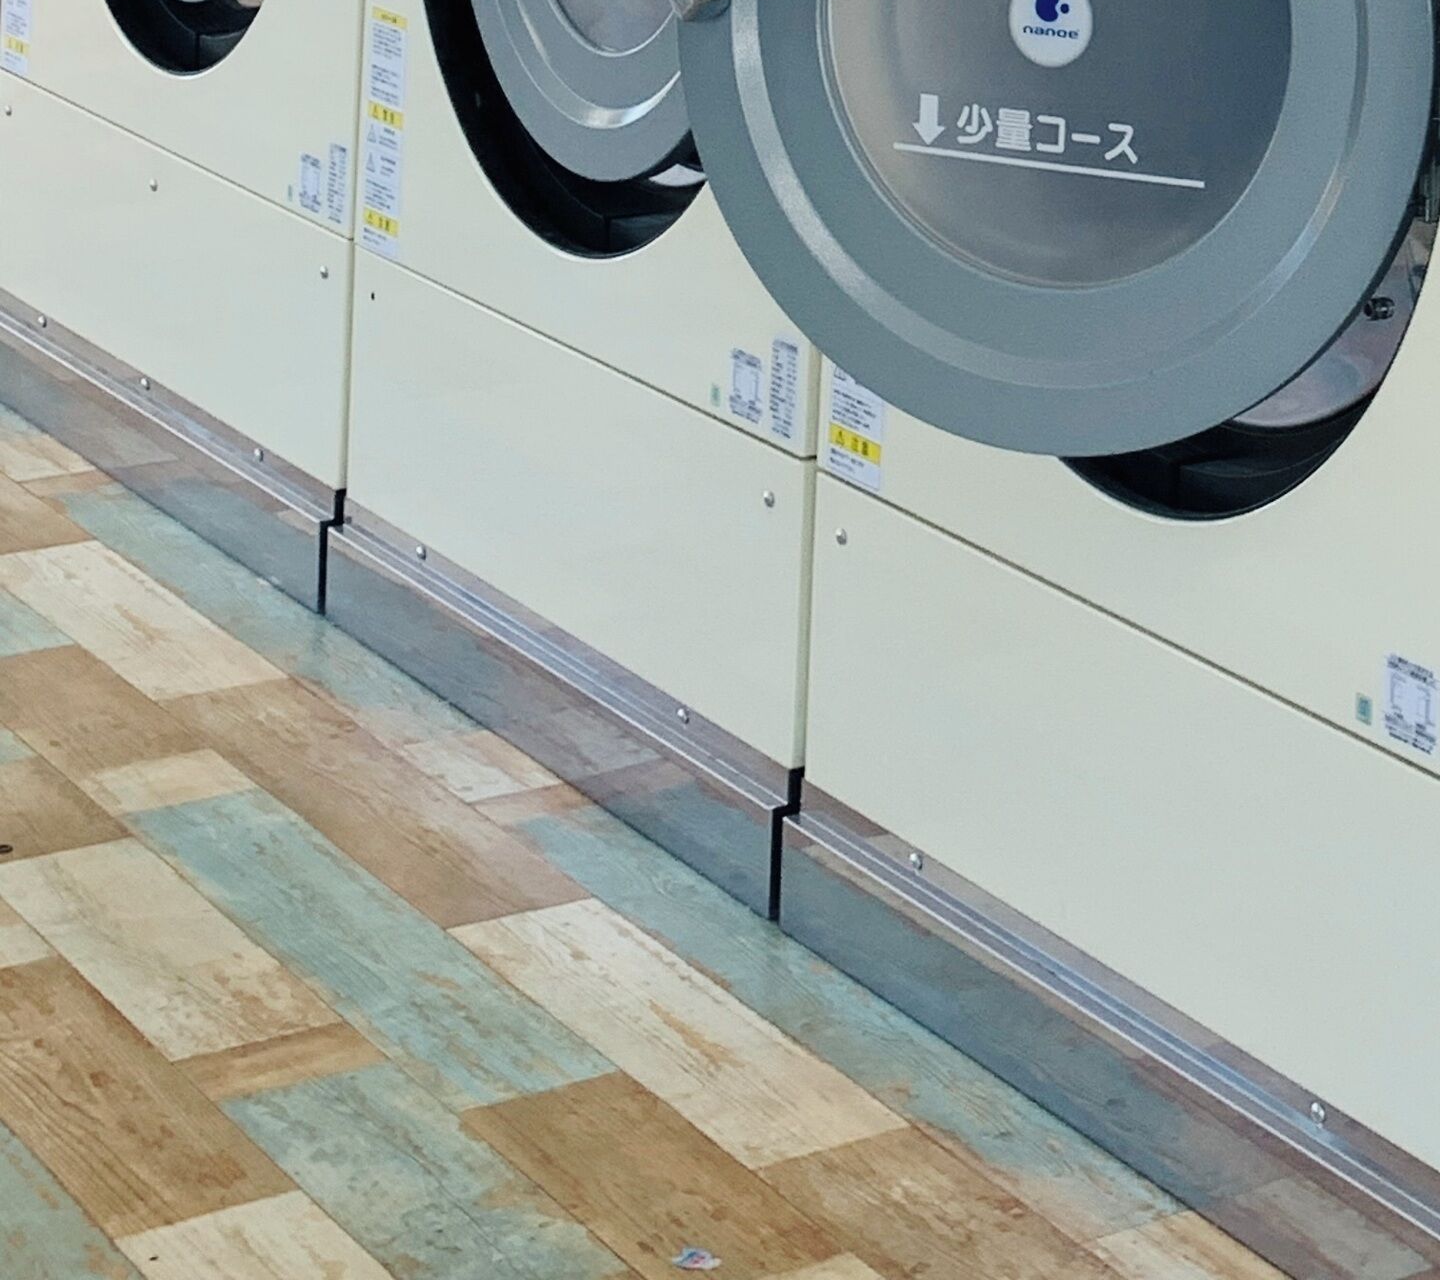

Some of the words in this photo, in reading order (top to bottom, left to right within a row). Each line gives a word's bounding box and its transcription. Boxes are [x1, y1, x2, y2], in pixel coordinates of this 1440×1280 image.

[1022, 23, 1080, 41] nanoe
[956, 102, 1139, 165] 少量コース
